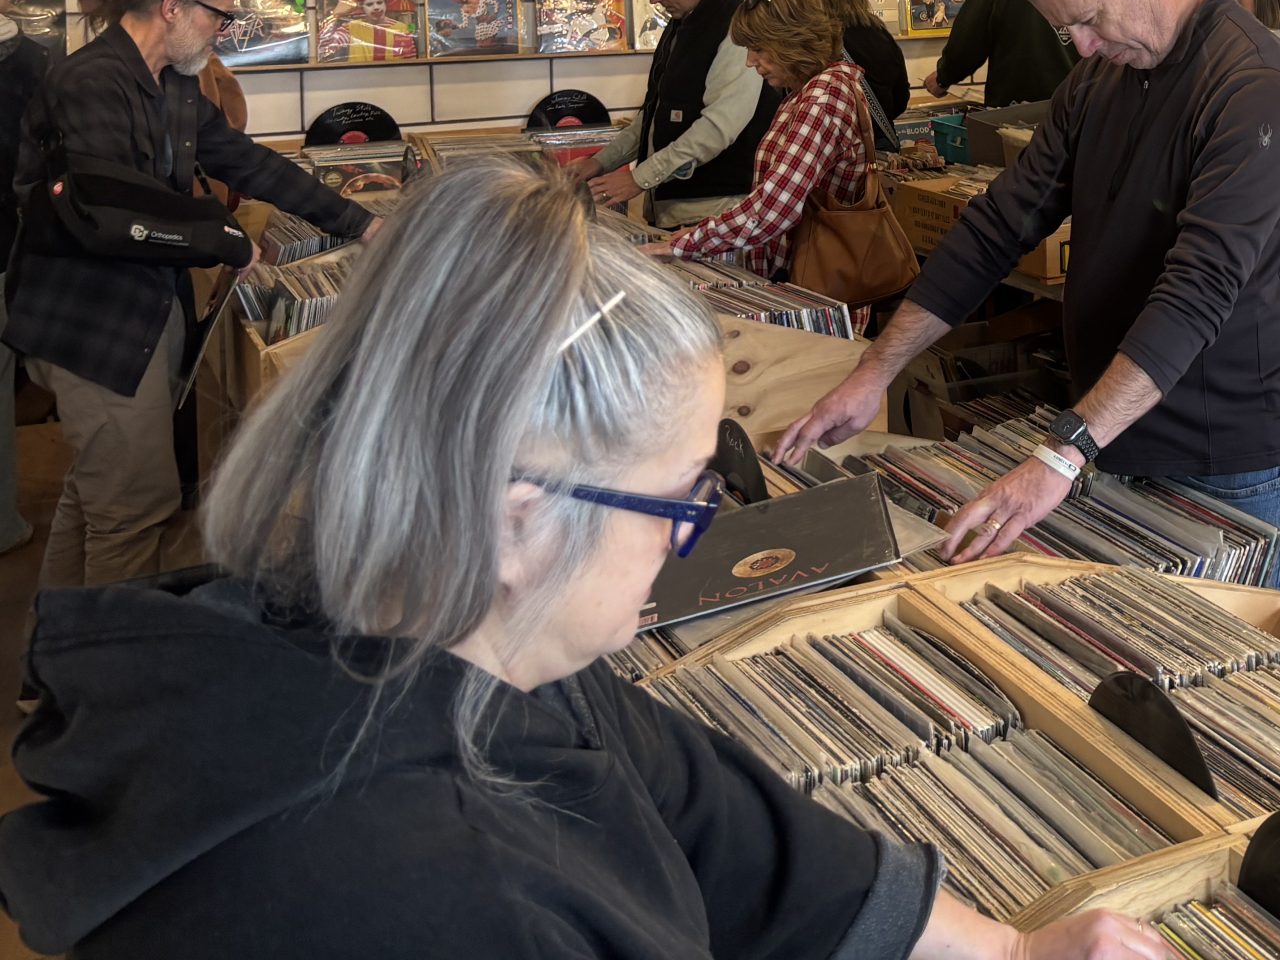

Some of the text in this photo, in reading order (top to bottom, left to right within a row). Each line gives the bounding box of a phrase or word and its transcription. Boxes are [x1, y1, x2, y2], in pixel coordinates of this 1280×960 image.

[906, 126, 930, 135] BLOOD
[151, 231, 183, 241] Orthopedics
[724, 424, 745, 458] Rock
[698, 562, 830, 606] AVALON
